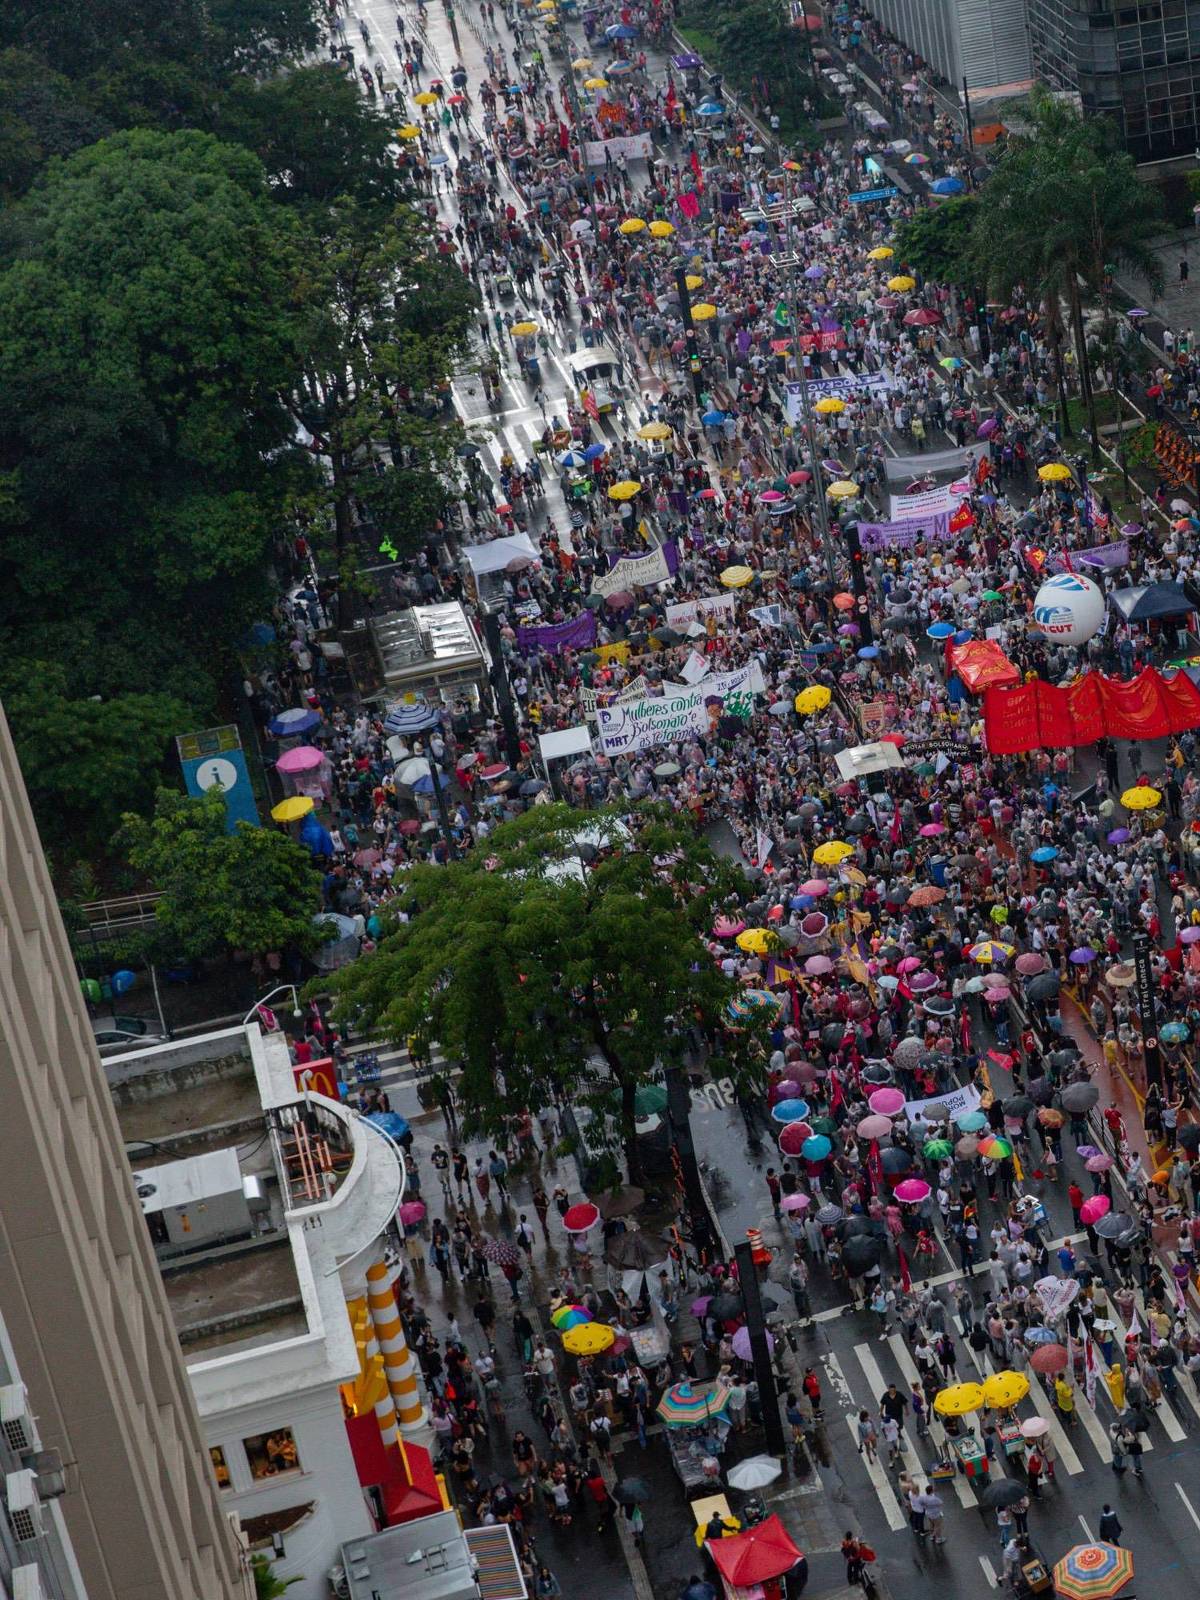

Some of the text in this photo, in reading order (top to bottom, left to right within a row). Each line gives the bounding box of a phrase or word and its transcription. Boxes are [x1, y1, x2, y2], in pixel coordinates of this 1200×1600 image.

[622, 701, 669, 722] Mulheres
[670, 692, 703, 713] contra
[631, 716, 687, 737] Bolsonaro
[605, 734, 629, 749] MRT
[1139, 959, 1148, 990] Caneca
[1141, 990, 1150, 1008] Frei
